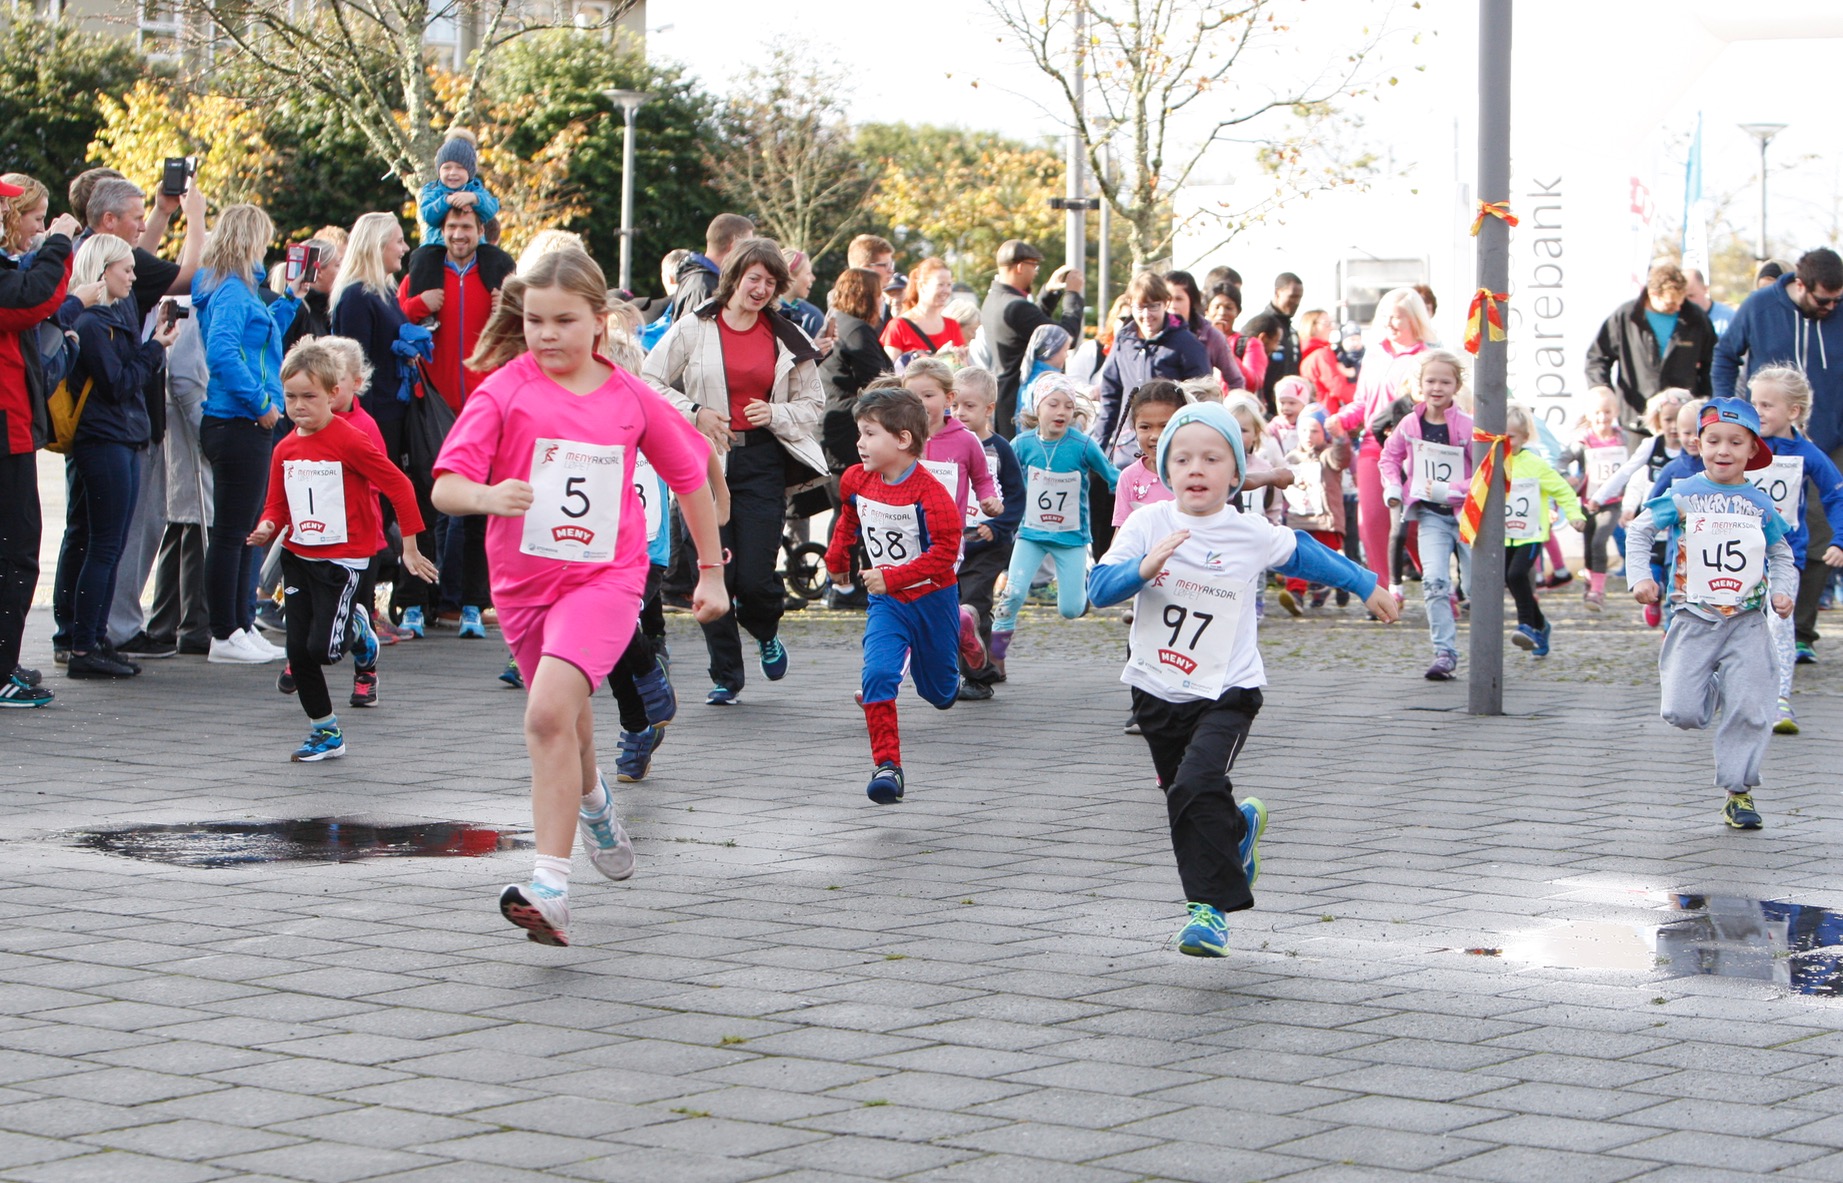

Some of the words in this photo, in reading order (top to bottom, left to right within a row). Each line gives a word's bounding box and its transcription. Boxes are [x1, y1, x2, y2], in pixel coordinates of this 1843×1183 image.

[1527, 175, 1573, 425] sparebank
[1425, 459, 1452, 482] 112
[560, 477, 590, 518] 5
[1038, 490, 1068, 512] 67
[301, 522, 323, 530] MENY
[556, 528, 592, 541] MENY
[867, 526, 907, 560] 58
[1702, 540, 1746, 572] 45
[1711, 579, 1740, 589] MENY
[1163, 604, 1213, 650] 97
[1161, 651, 1194, 671] MENY
